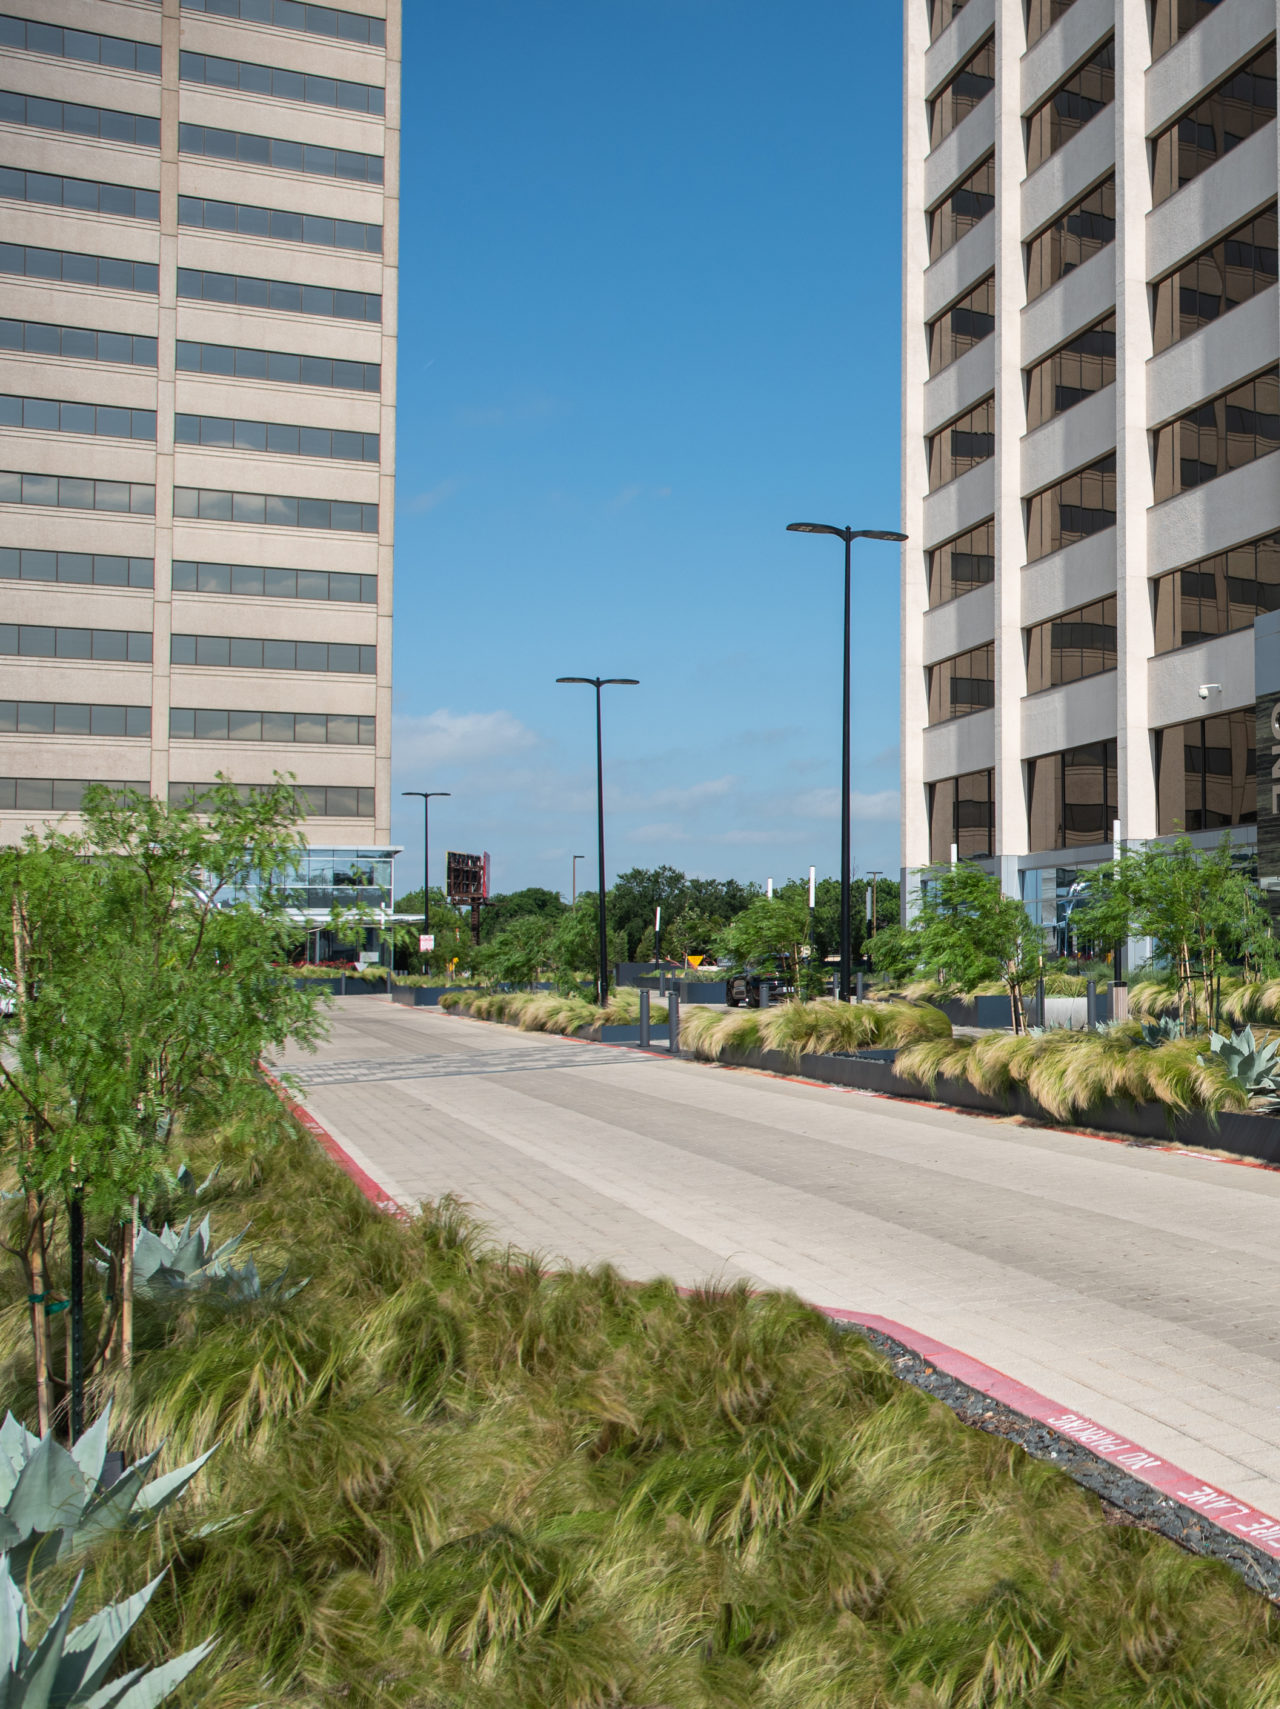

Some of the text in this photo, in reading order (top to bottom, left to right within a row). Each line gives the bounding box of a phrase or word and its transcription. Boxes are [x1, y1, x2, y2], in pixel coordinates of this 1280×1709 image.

[1047, 1414, 1131, 1453] PARKING
[1117, 1452, 1161, 1470] NO
[1177, 1486, 1250, 1519] LANE
